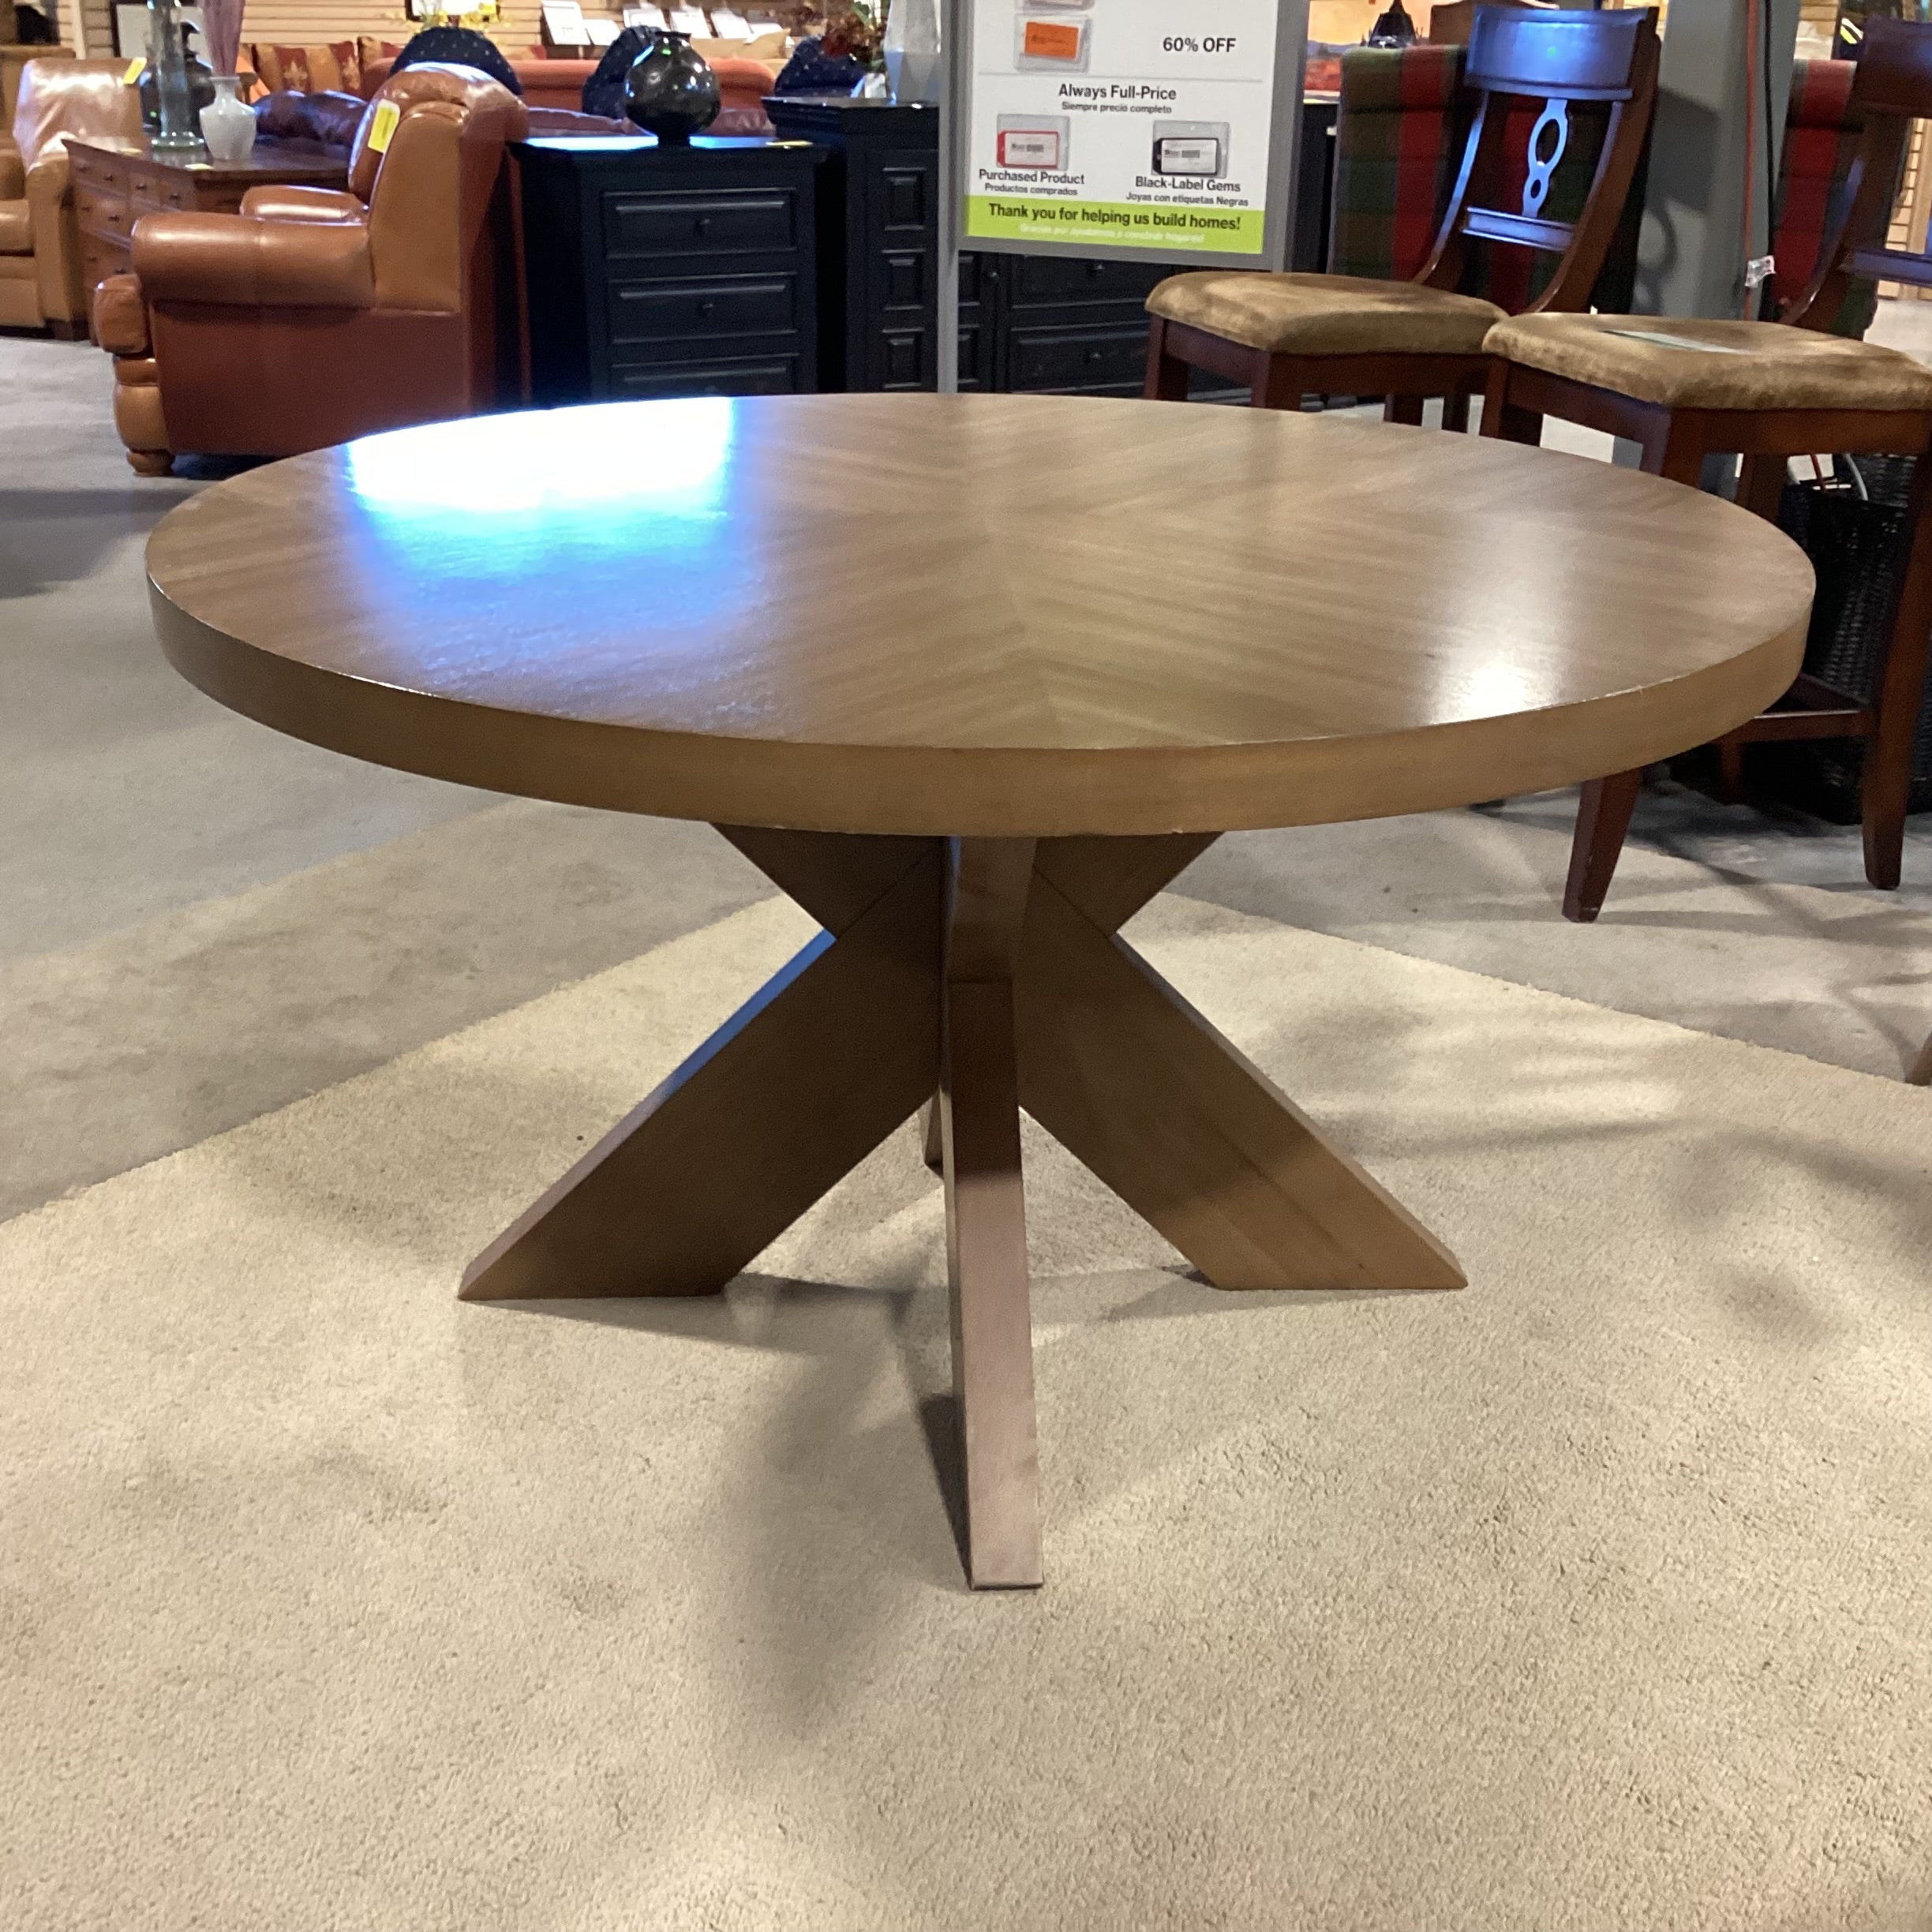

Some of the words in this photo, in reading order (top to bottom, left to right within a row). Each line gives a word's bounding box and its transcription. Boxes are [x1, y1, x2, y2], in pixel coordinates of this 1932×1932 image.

[1163, 36, 1199, 52] 60%
[1203, 37, 1237, 52] OFF
[1058, 83, 1106, 100] Always
[1110, 84, 1177, 99] Full-Price
[1061, 101, 1097, 112] Siempre
[1100, 103, 1127, 112] precio
[1129, 105, 1172, 114] completo
[979, 169, 1038, 182] Purchased
[1040, 171, 1084, 184] Product
[1136, 176, 1204, 190] Black-Label
[1207, 179, 1241, 192] Gems
[985, 182, 1028, 193] Productos
[1030, 186, 1078, 196] comprados
[1126, 192, 1151, 202] Joyas
[1172, 195, 1214, 205] etiquetas
[1216, 197, 1249, 208] Negras
[989, 203, 1028, 218] Thank
[1032, 208, 1056, 220] you
[1059, 207, 1078, 220] for
[1082, 208, 1130, 227] helping
[1133, 215, 1149, 225] us
[1153, 212, 1186, 227] build
[1189, 215, 1241, 230] homes!
